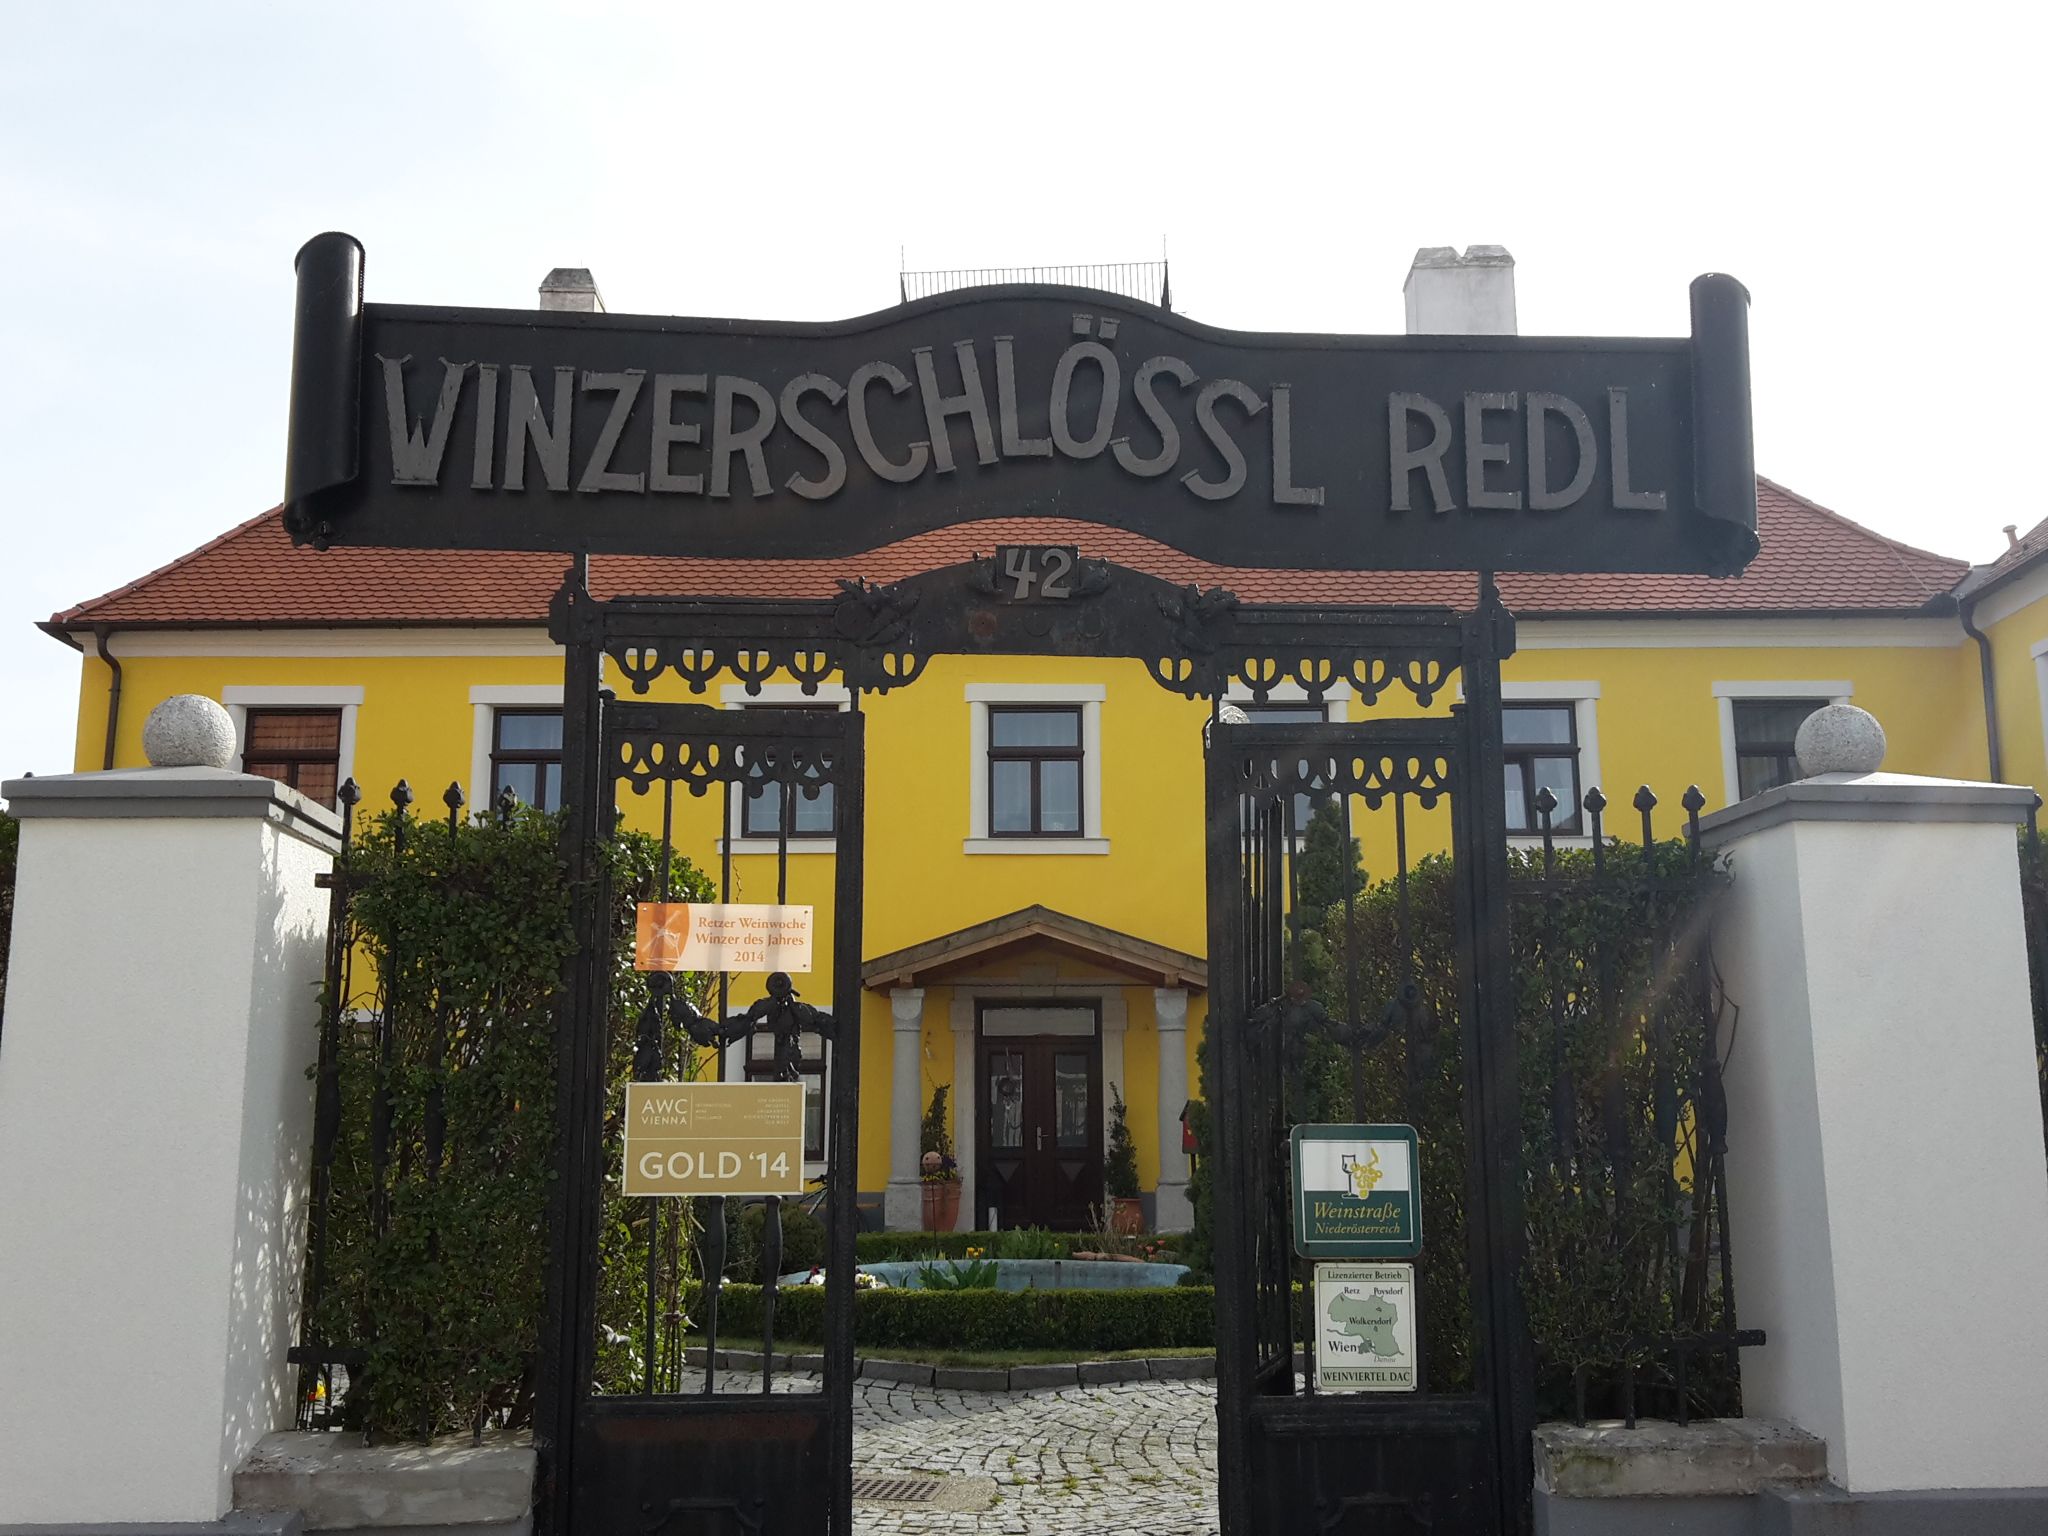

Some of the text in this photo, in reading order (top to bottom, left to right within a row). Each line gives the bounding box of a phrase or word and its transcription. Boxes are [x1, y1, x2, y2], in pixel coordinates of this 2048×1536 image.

[374, 313, 1667, 512] WINZERSCHLÖSSL REDL
[1005, 548, 1073, 599] 42
[698, 917, 806, 930] Retzer Weinwoche
[696, 933, 804, 947] Winzer des Jahres
[734, 951, 765, 962] 2014
[641, 1098, 688, 1115] AWC
[641, 1115, 687, 1125] VIENNA
[639, 1151, 742, 1179] GOLD
[1313, 1201, 1401, 1223] Weinstraße
[1315, 1222, 1401, 1234] Niederösterreich
[1327, 1270, 1402, 1279] Lizenzierter Betrieb
[1343, 1286, 1360, 1294] Retz
[1349, 1316, 1392, 1325] Wolkersdorf
[1328, 1340, 1357, 1352] Wien
[1323, 1372, 1411, 1382] WEINVIERTEL DAC
